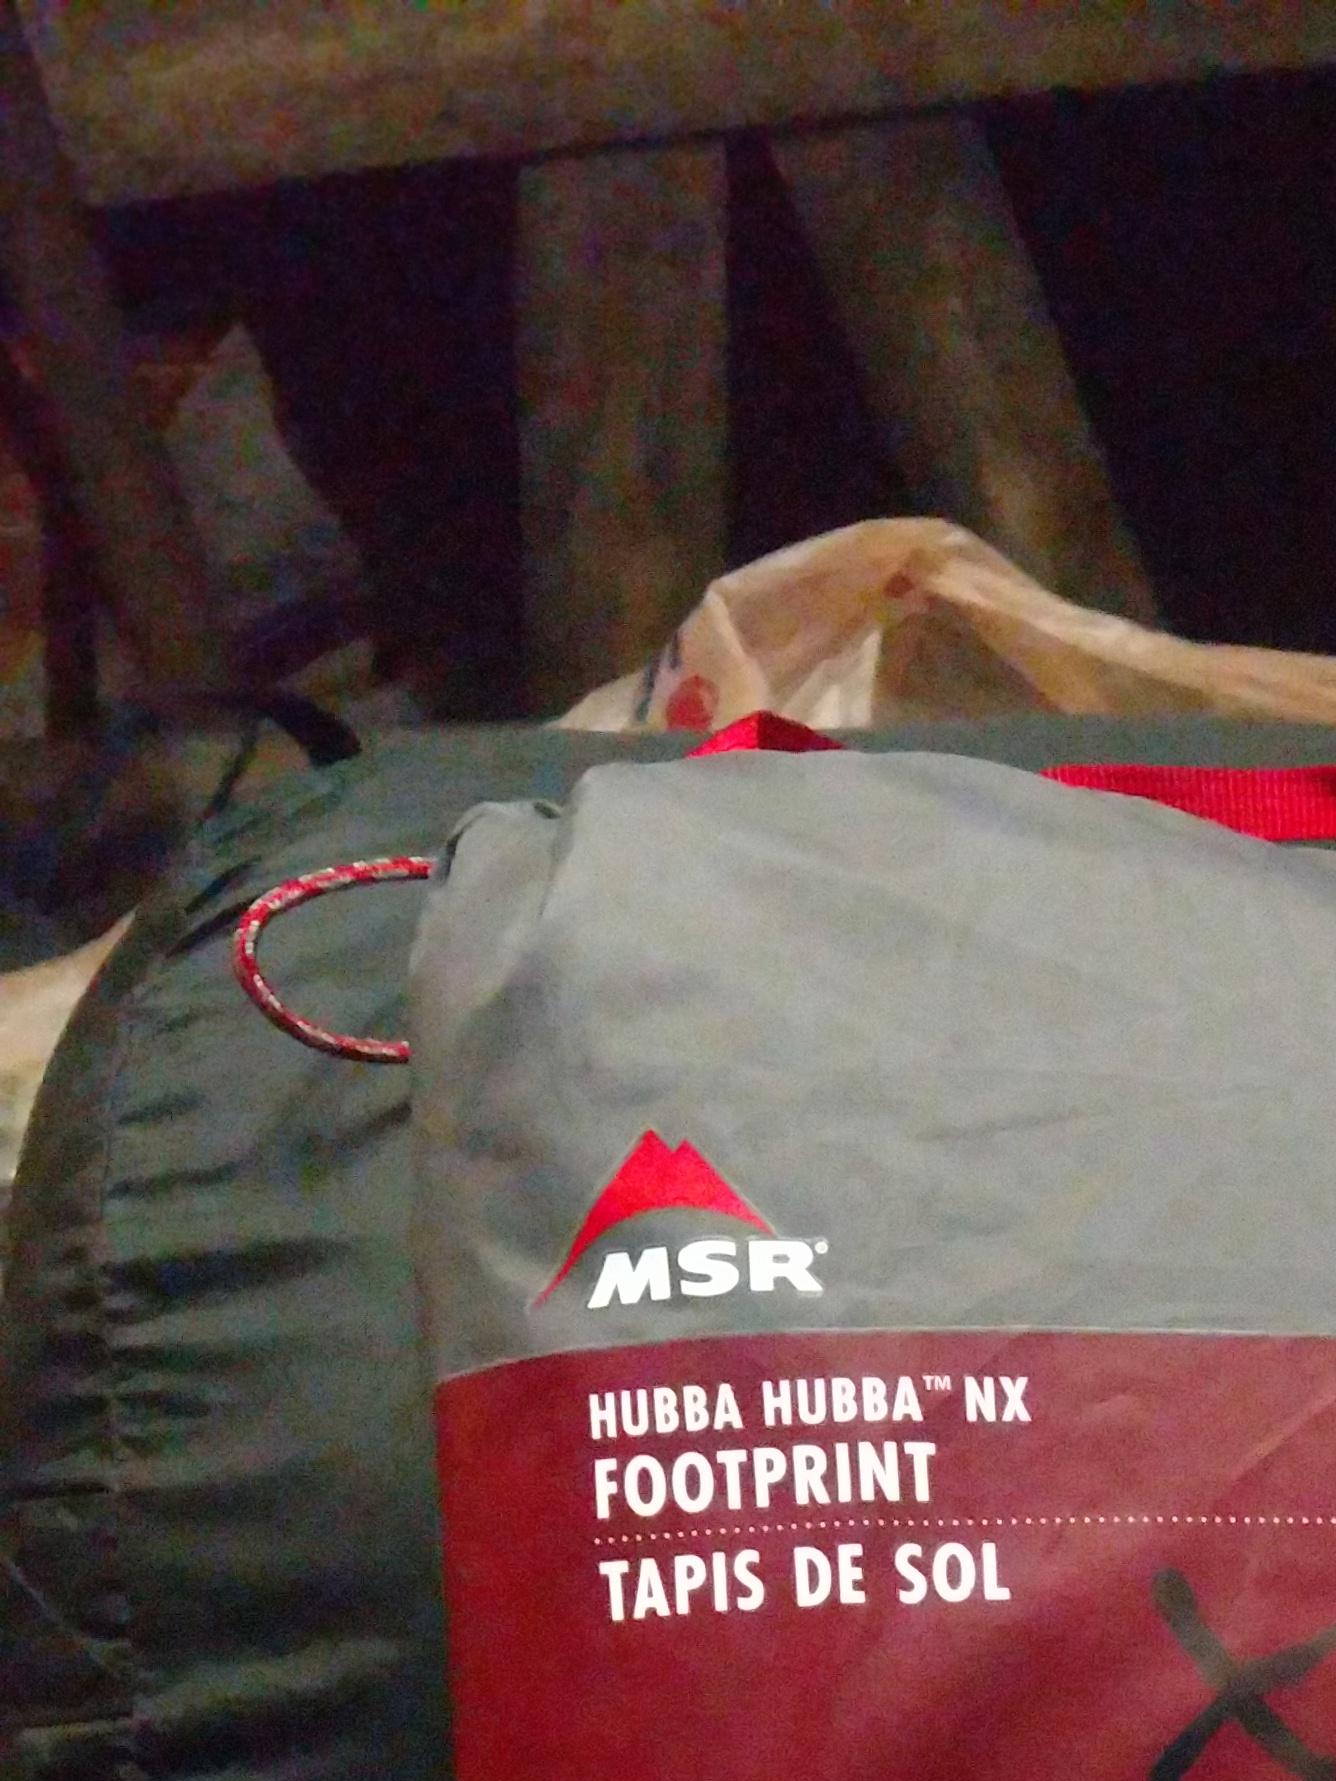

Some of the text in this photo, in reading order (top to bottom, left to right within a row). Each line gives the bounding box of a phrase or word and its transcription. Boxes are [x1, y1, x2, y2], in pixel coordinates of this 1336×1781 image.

[589, 1383, 743, 1439] HUBBA
[964, 1376, 1032, 1422] NX
[595, 1441, 936, 1518] FOOTPRINT
[599, 1542, 1011, 1621] TAPIS DE SOL
